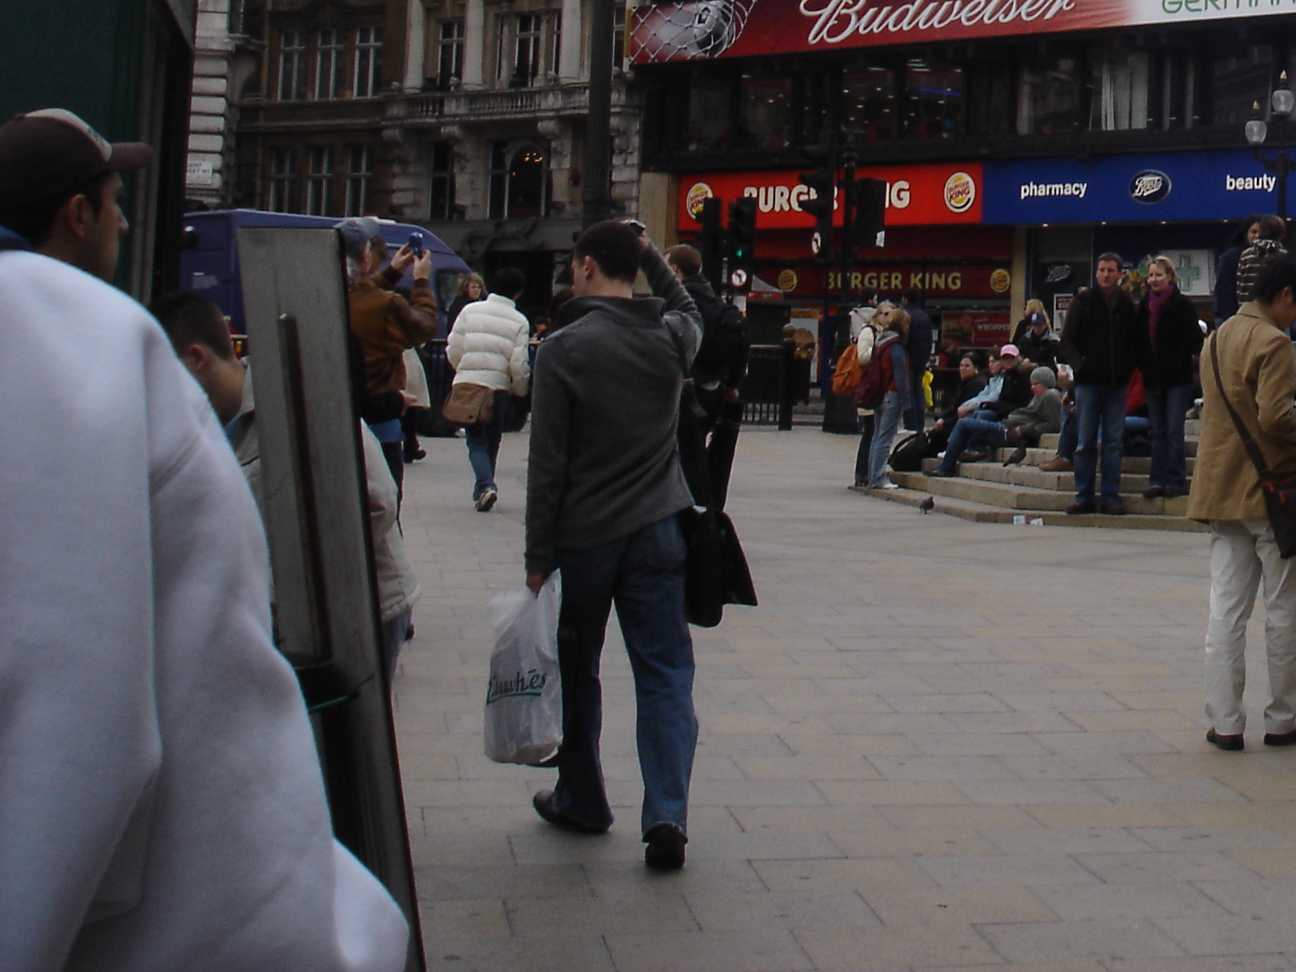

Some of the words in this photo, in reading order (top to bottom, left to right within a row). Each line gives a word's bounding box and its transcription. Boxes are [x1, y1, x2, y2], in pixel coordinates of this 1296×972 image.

[1020, 181, 1087, 199] pharmacy
[1226, 173, 1276, 192] beauty
[910, 272, 962, 290] KING
